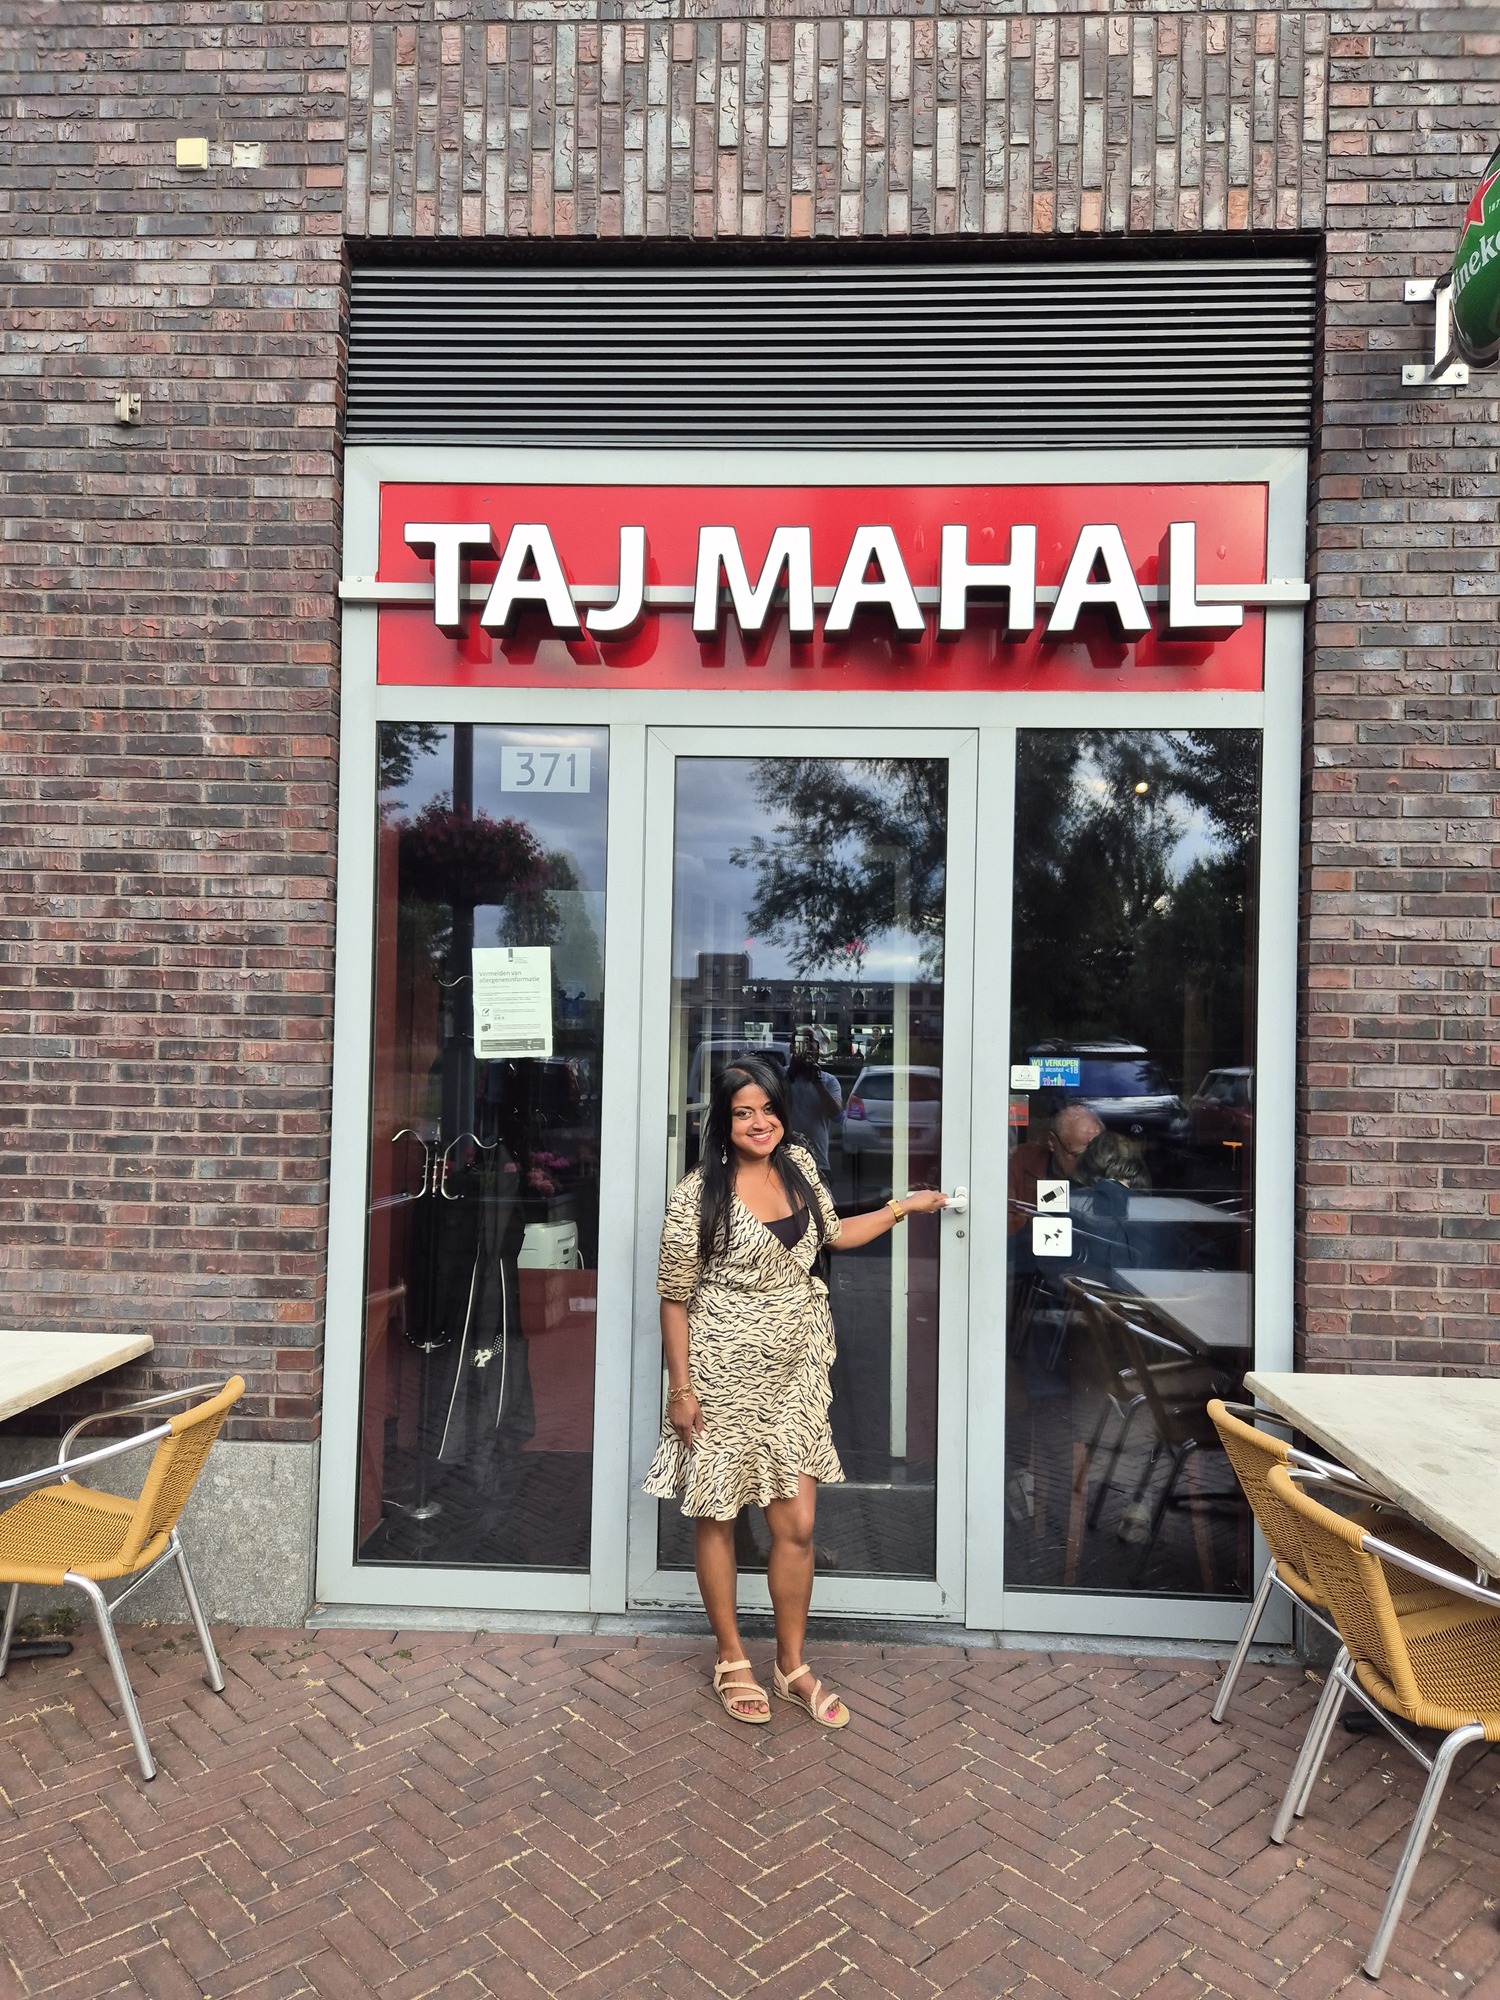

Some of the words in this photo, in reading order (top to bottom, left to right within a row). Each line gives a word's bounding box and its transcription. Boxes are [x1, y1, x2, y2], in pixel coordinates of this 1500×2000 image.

[404, 522, 646, 632] TAJ
[692, 521, 1244, 632] MAHAL
[516, 752, 576, 787] 371
[479, 976, 540, 984] allergeneninformatie
[1045, 1059, 1079, 1067] VERKOPEN
